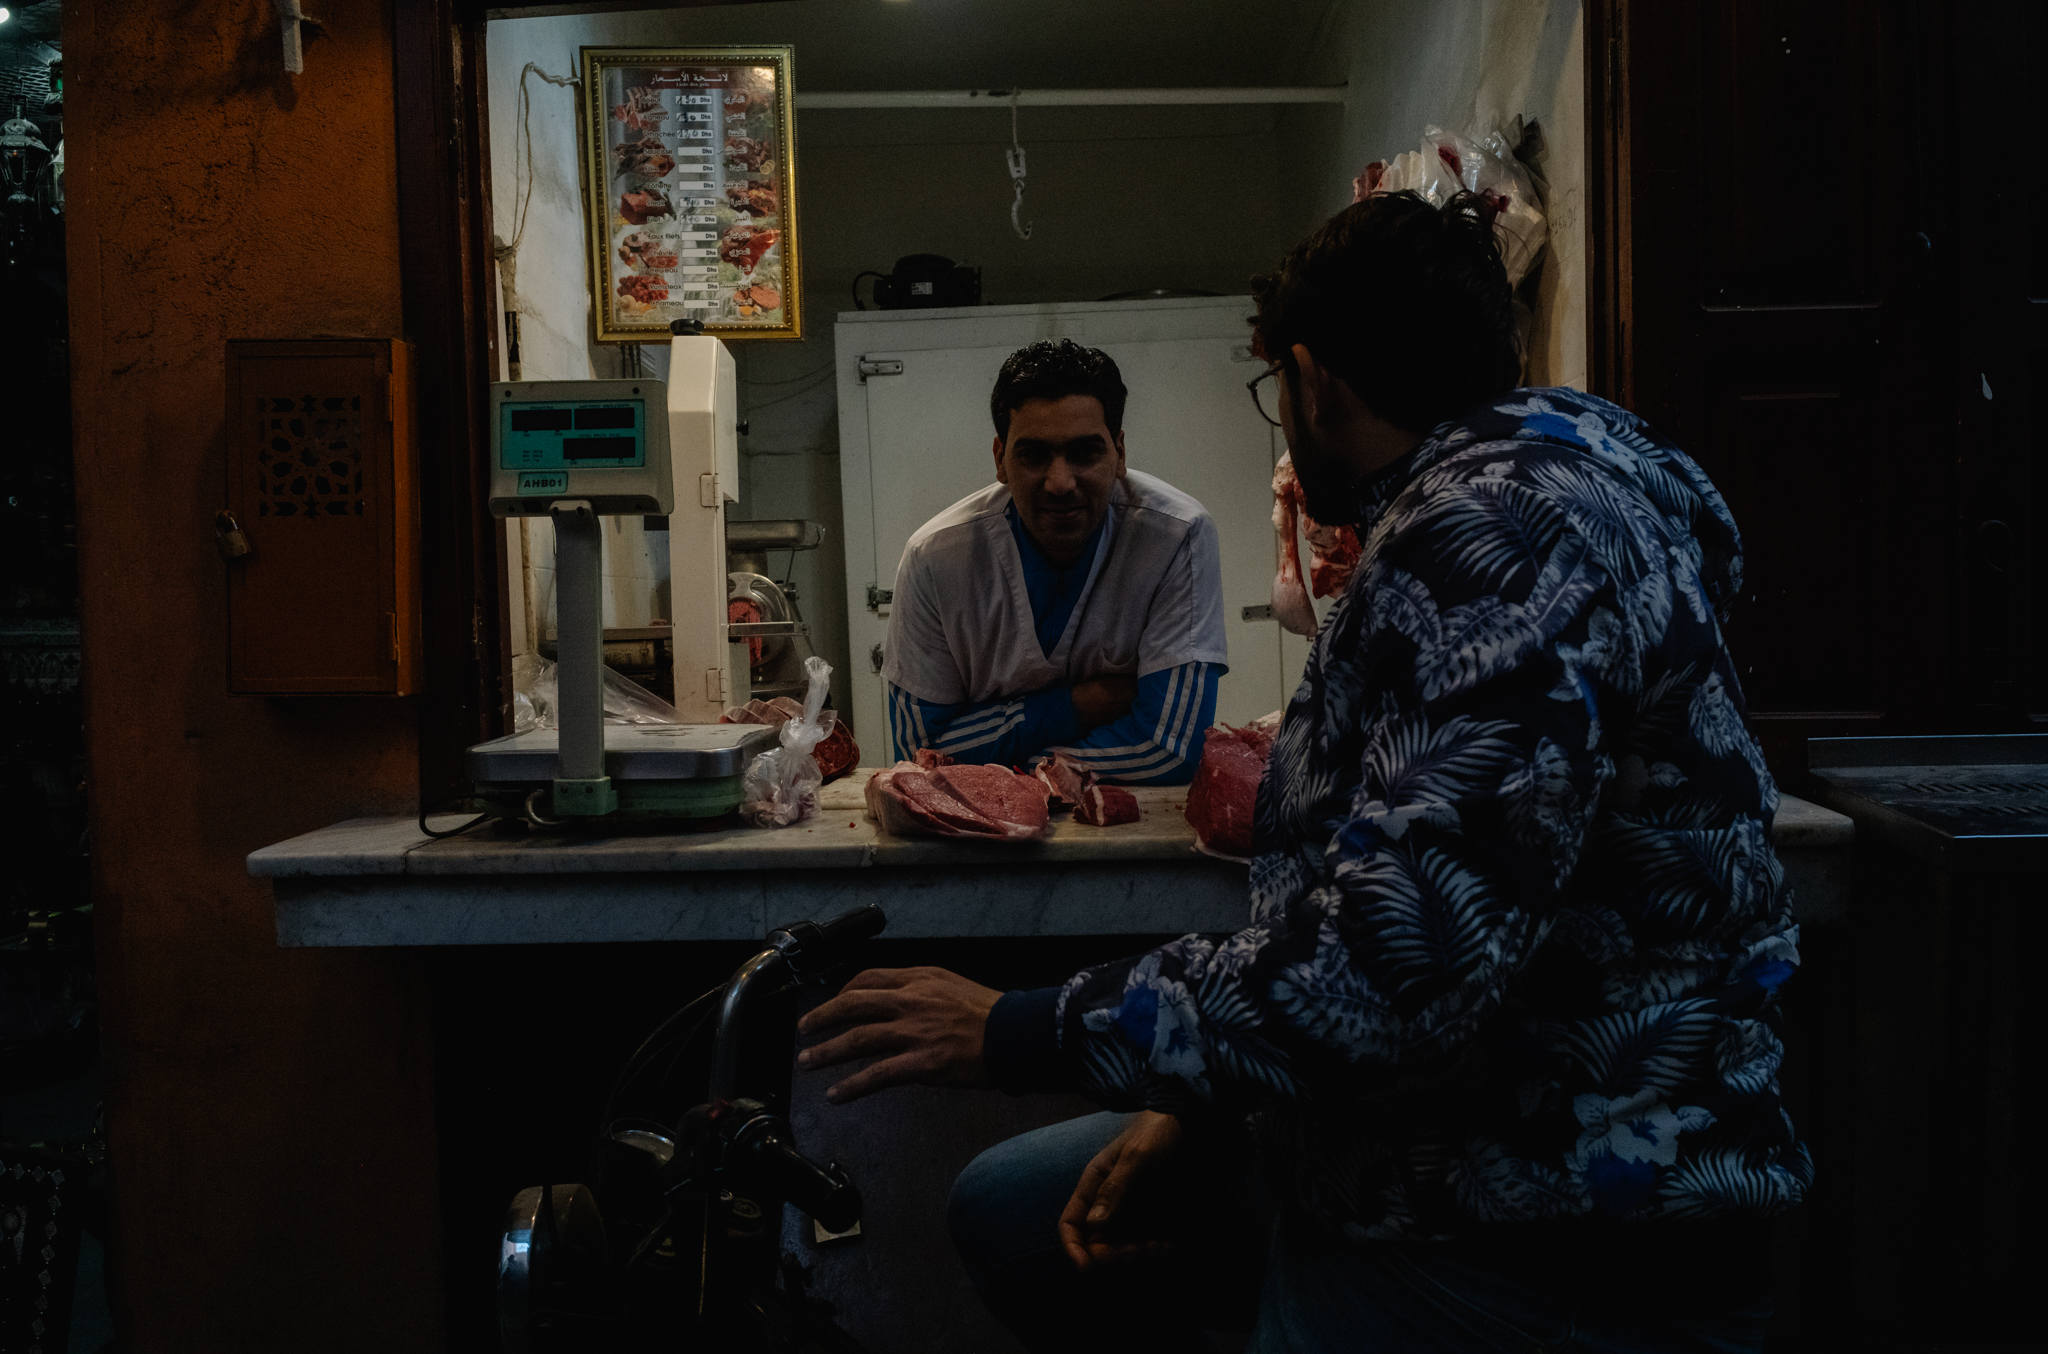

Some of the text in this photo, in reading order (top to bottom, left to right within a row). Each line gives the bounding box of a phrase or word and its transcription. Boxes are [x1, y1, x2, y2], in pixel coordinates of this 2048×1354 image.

[650, 71, 729, 84] لائحة الأسعار
[642, 114, 670, 122] Agneau
[523, 479, 562, 488] AHB01
